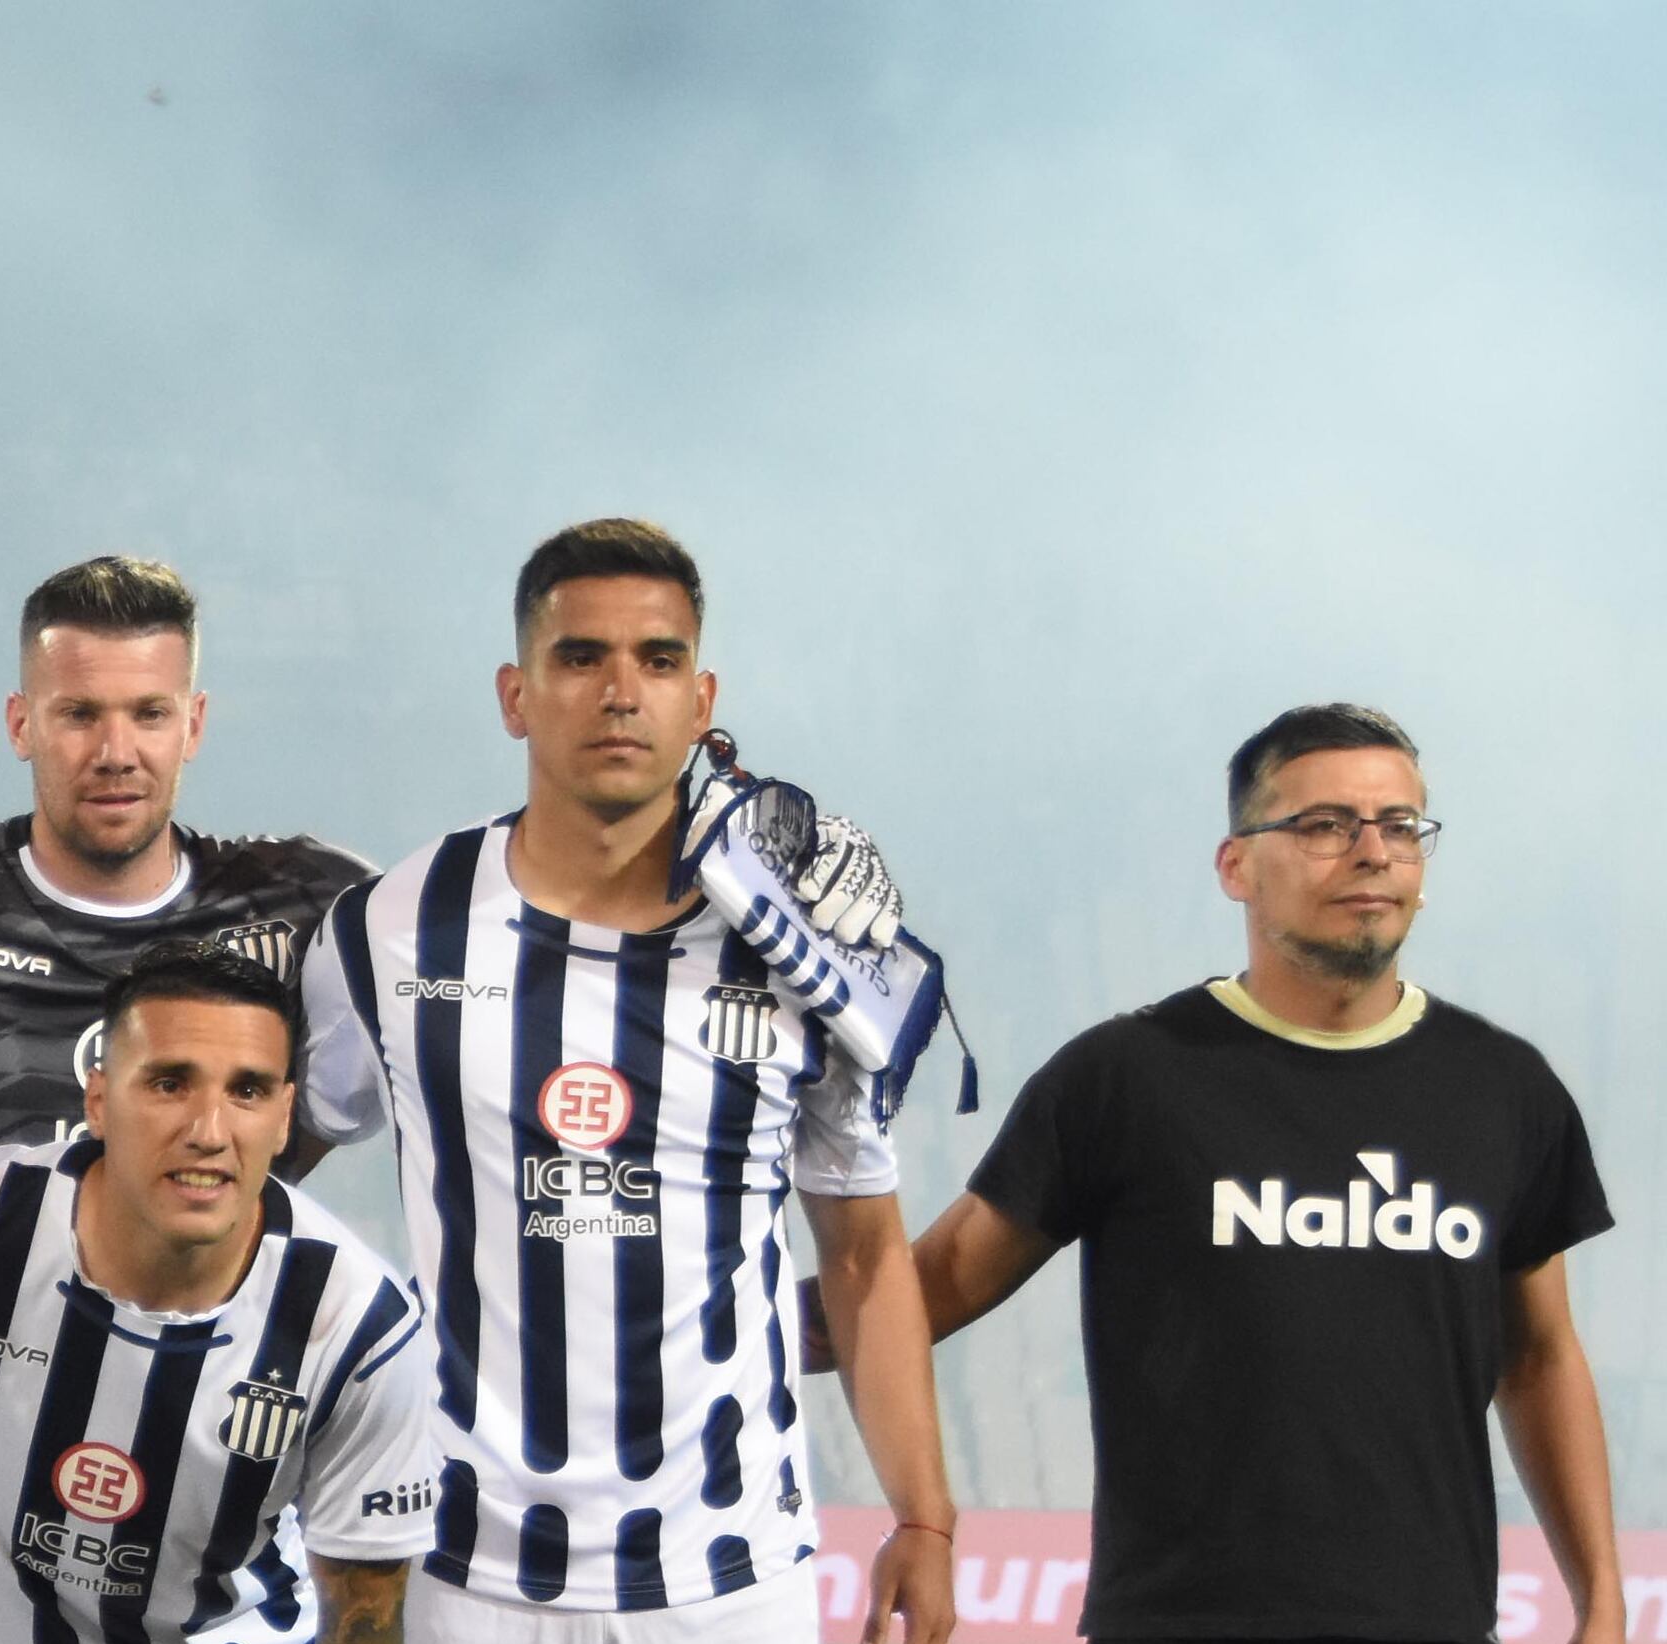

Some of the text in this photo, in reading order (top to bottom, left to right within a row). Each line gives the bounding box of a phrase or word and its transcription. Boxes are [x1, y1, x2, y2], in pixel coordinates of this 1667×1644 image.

[395, 980, 508, 1001] GIVOVA
[720, 988, 763, 1002] C.A.T
[524, 1157, 660, 1199] ICBC
[1213, 1152, 1482, 1259] Naldo
[524, 1211, 655, 1240] Argentina
[248, 1387, 288, 1404] C.A.T
[19, 1513, 150, 1576] ICBC
[15, 1551, 142, 1598] Argentina
